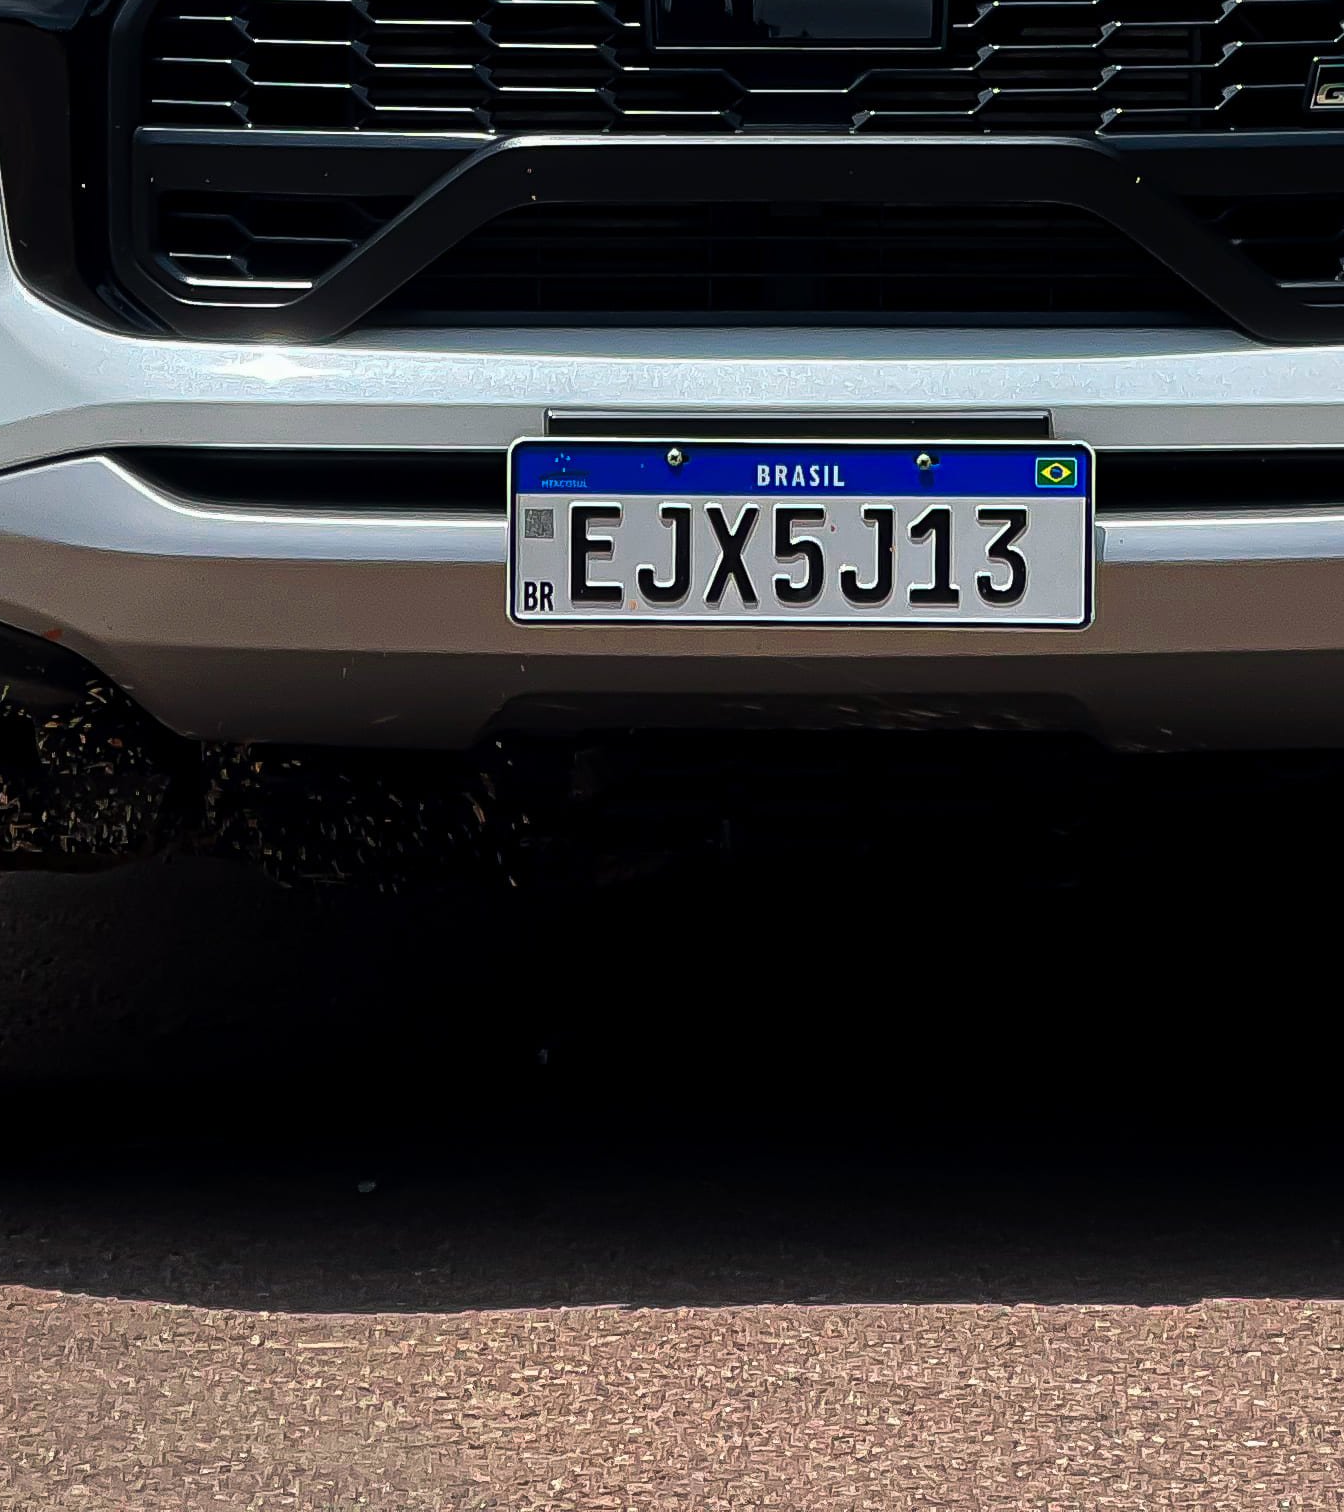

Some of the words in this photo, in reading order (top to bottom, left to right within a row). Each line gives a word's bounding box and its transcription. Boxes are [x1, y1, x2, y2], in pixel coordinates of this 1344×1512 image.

[757, 464, 846, 488] BRASIL
[568, 501, 1030, 609] EJX5J13
[523, 581, 554, 612] BR
